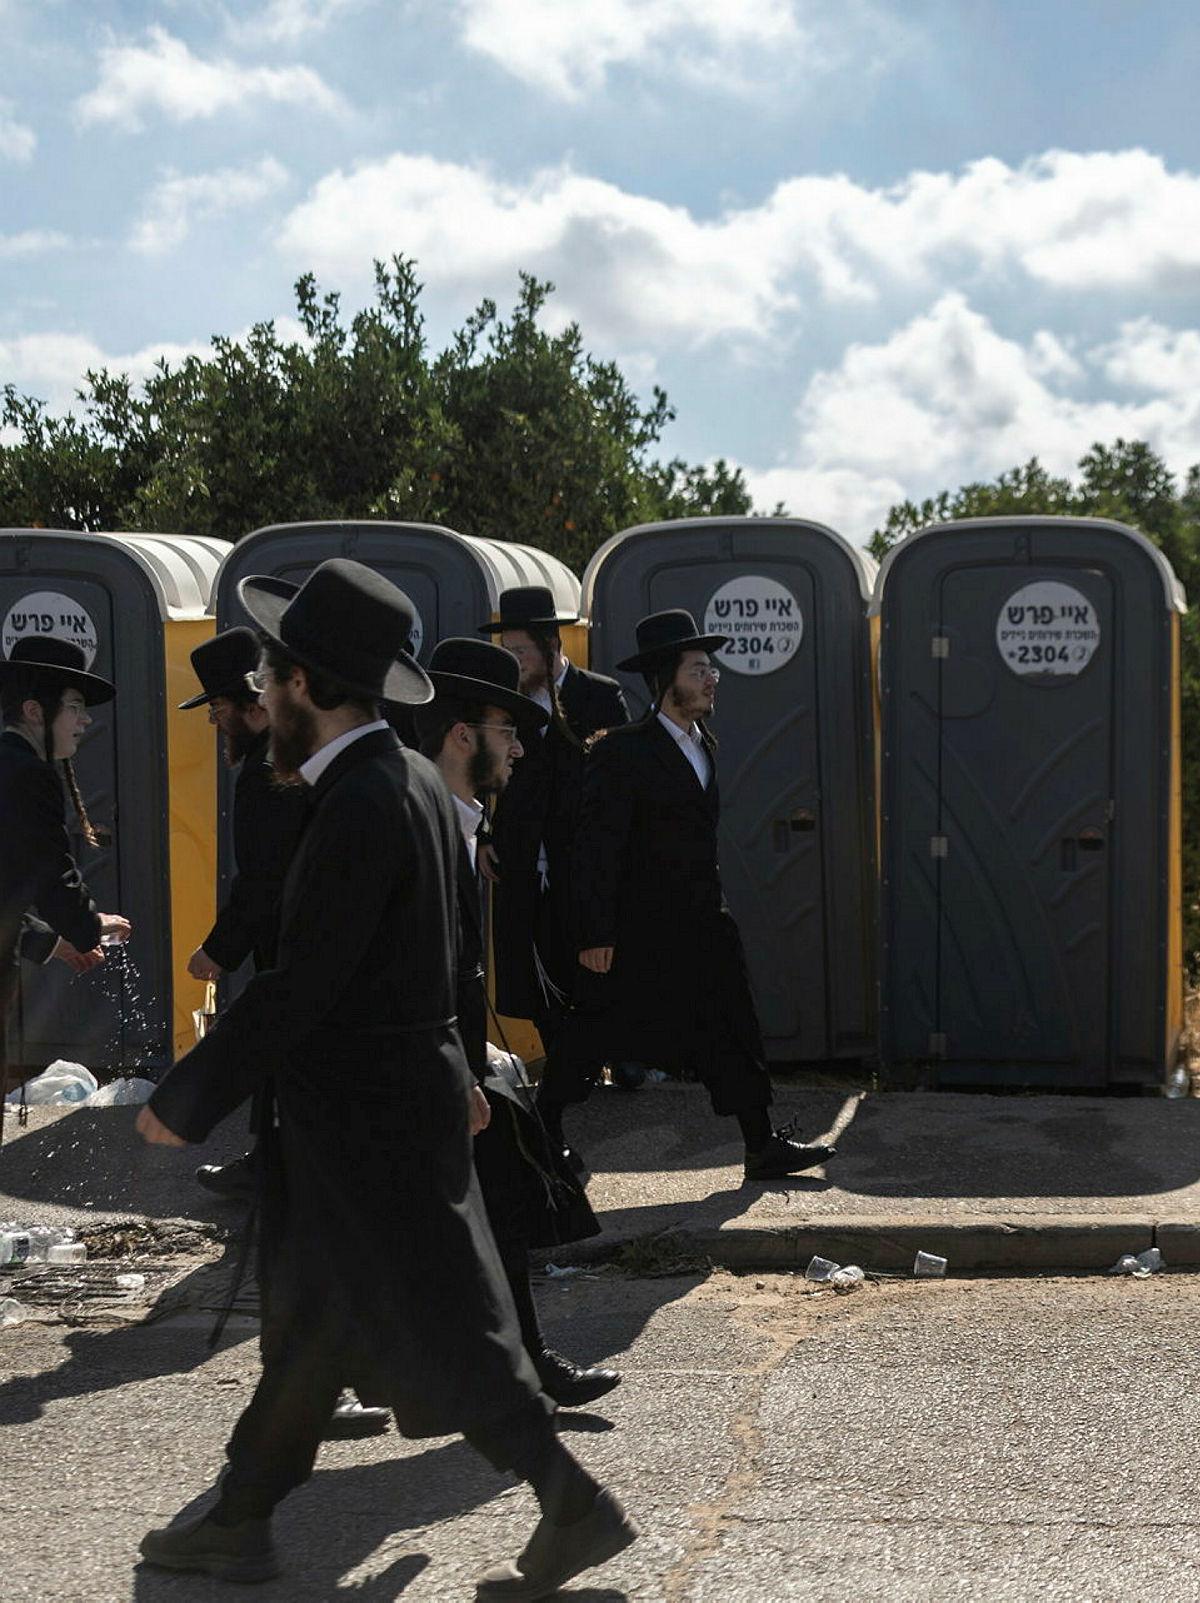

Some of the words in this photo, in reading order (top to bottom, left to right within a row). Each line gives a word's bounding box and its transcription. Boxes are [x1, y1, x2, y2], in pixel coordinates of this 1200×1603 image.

[714, 598, 759, 617] פרש
[764, 597, 793, 616] איי
[1008, 605, 1054, 625] פרש
[1061, 605, 1088, 624] איי
[11, 613, 55, 632] פרש
[60, 614, 86, 633] איי
[770, 621, 799, 632] השכרת
